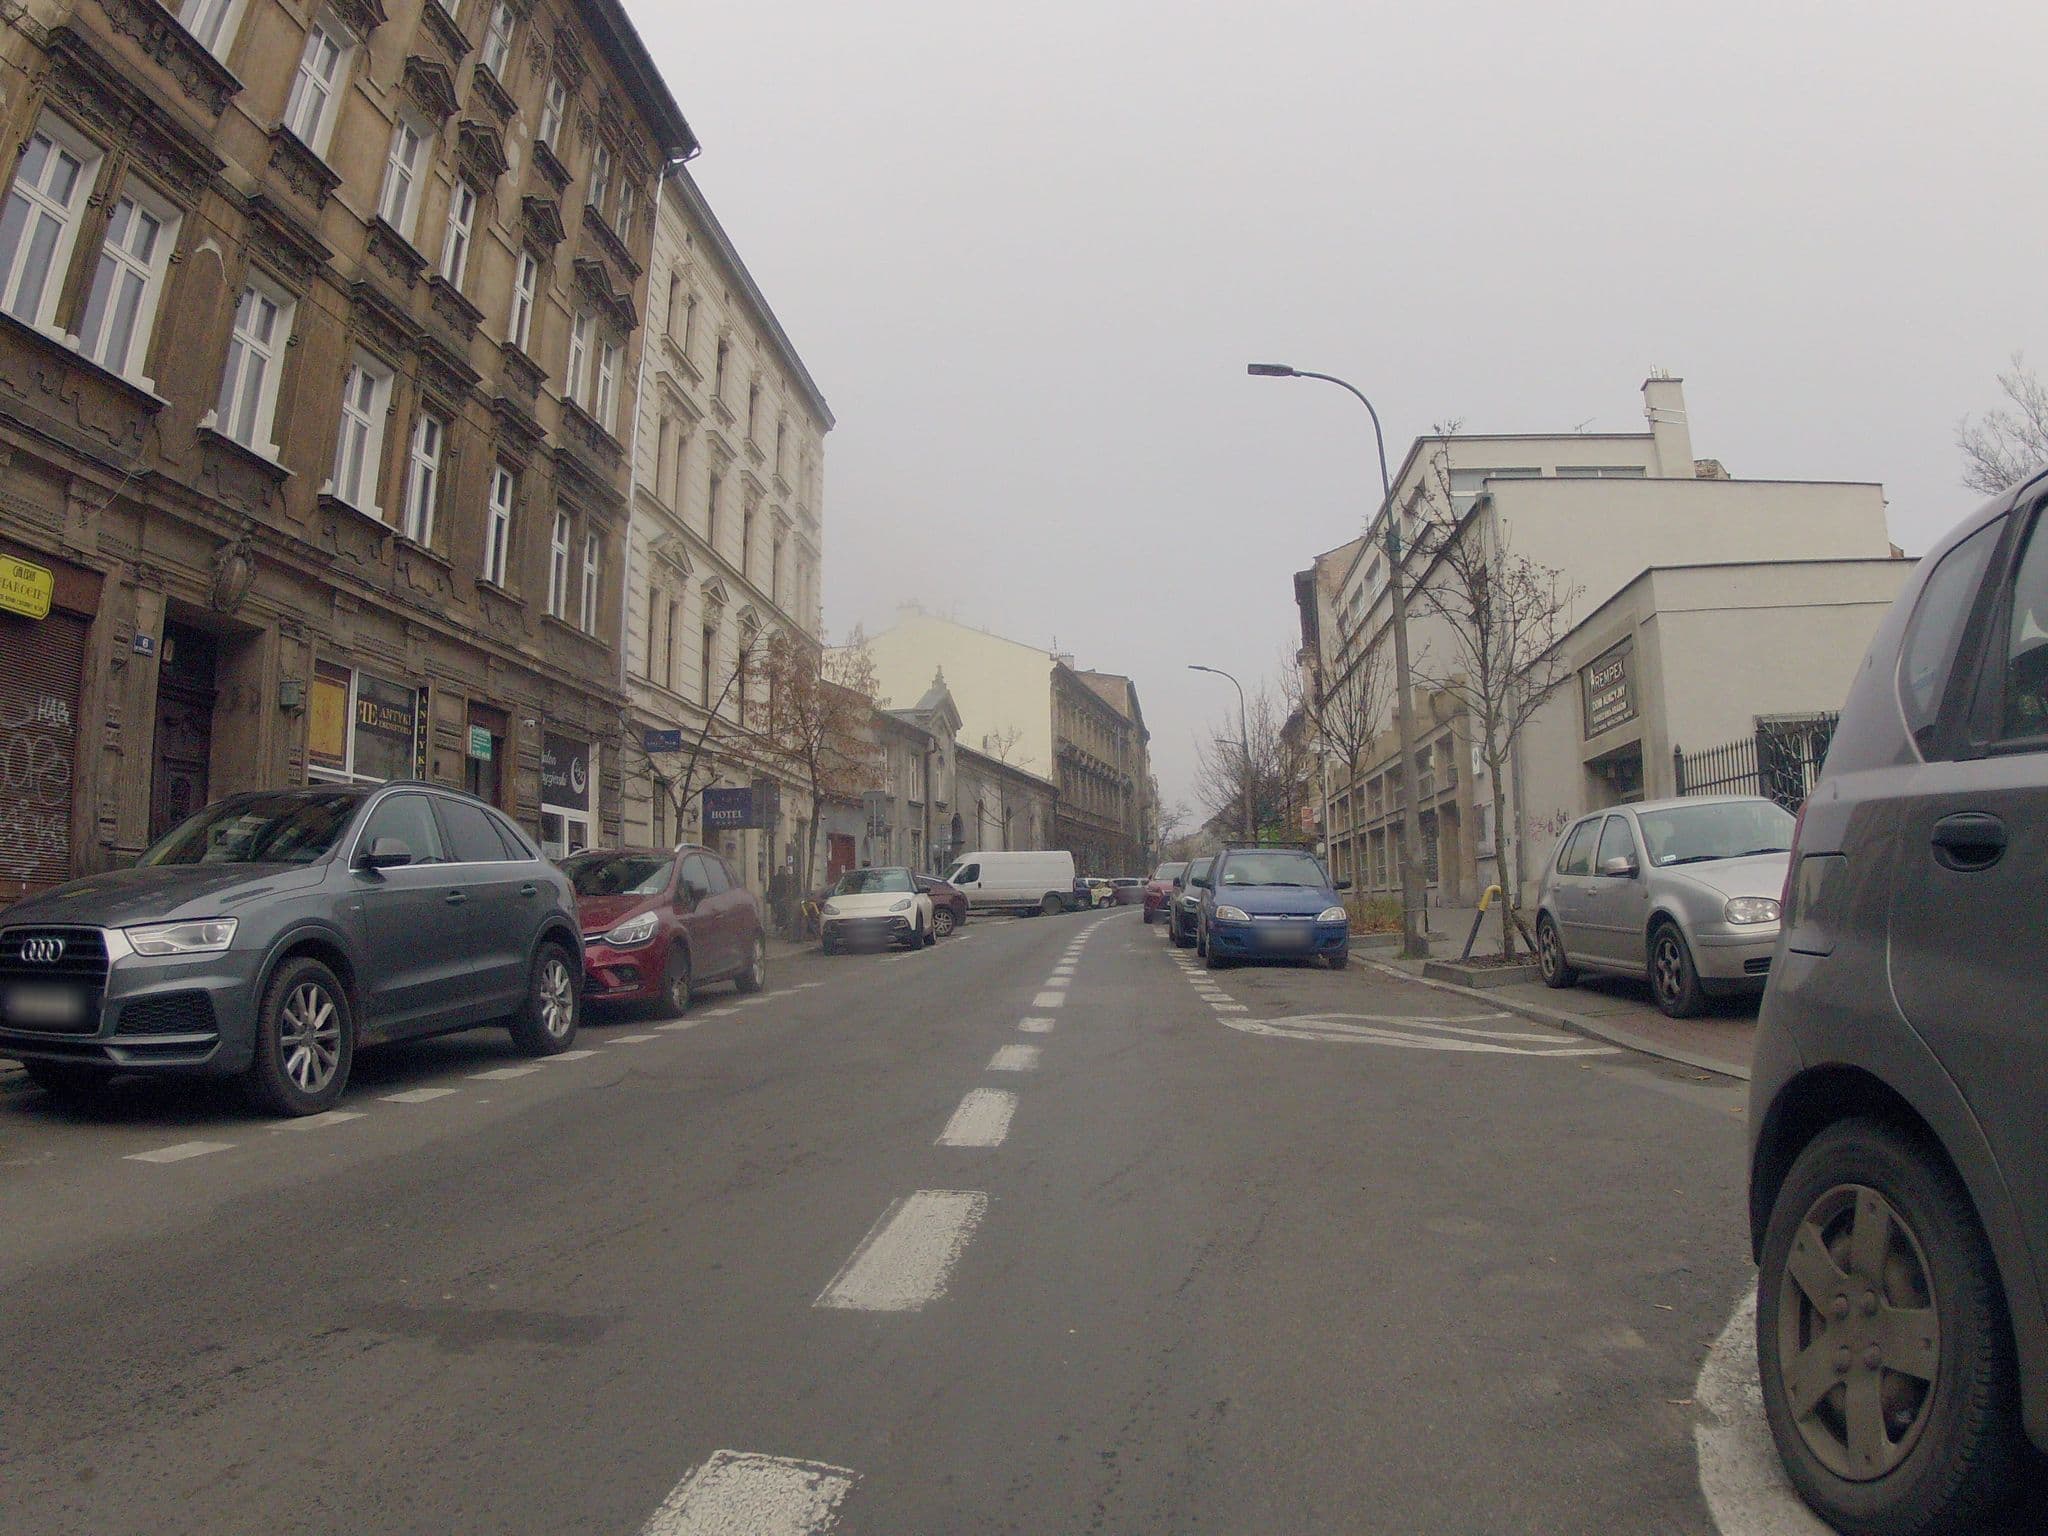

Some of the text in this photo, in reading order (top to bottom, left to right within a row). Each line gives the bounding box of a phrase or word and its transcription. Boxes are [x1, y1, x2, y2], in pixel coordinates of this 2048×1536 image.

[1594, 659, 1625, 689] REMPEX
[418, 695, 427, 779] ANTYKI
[541, 749, 556, 765] alon
[711, 810, 743, 820] HOTEL
